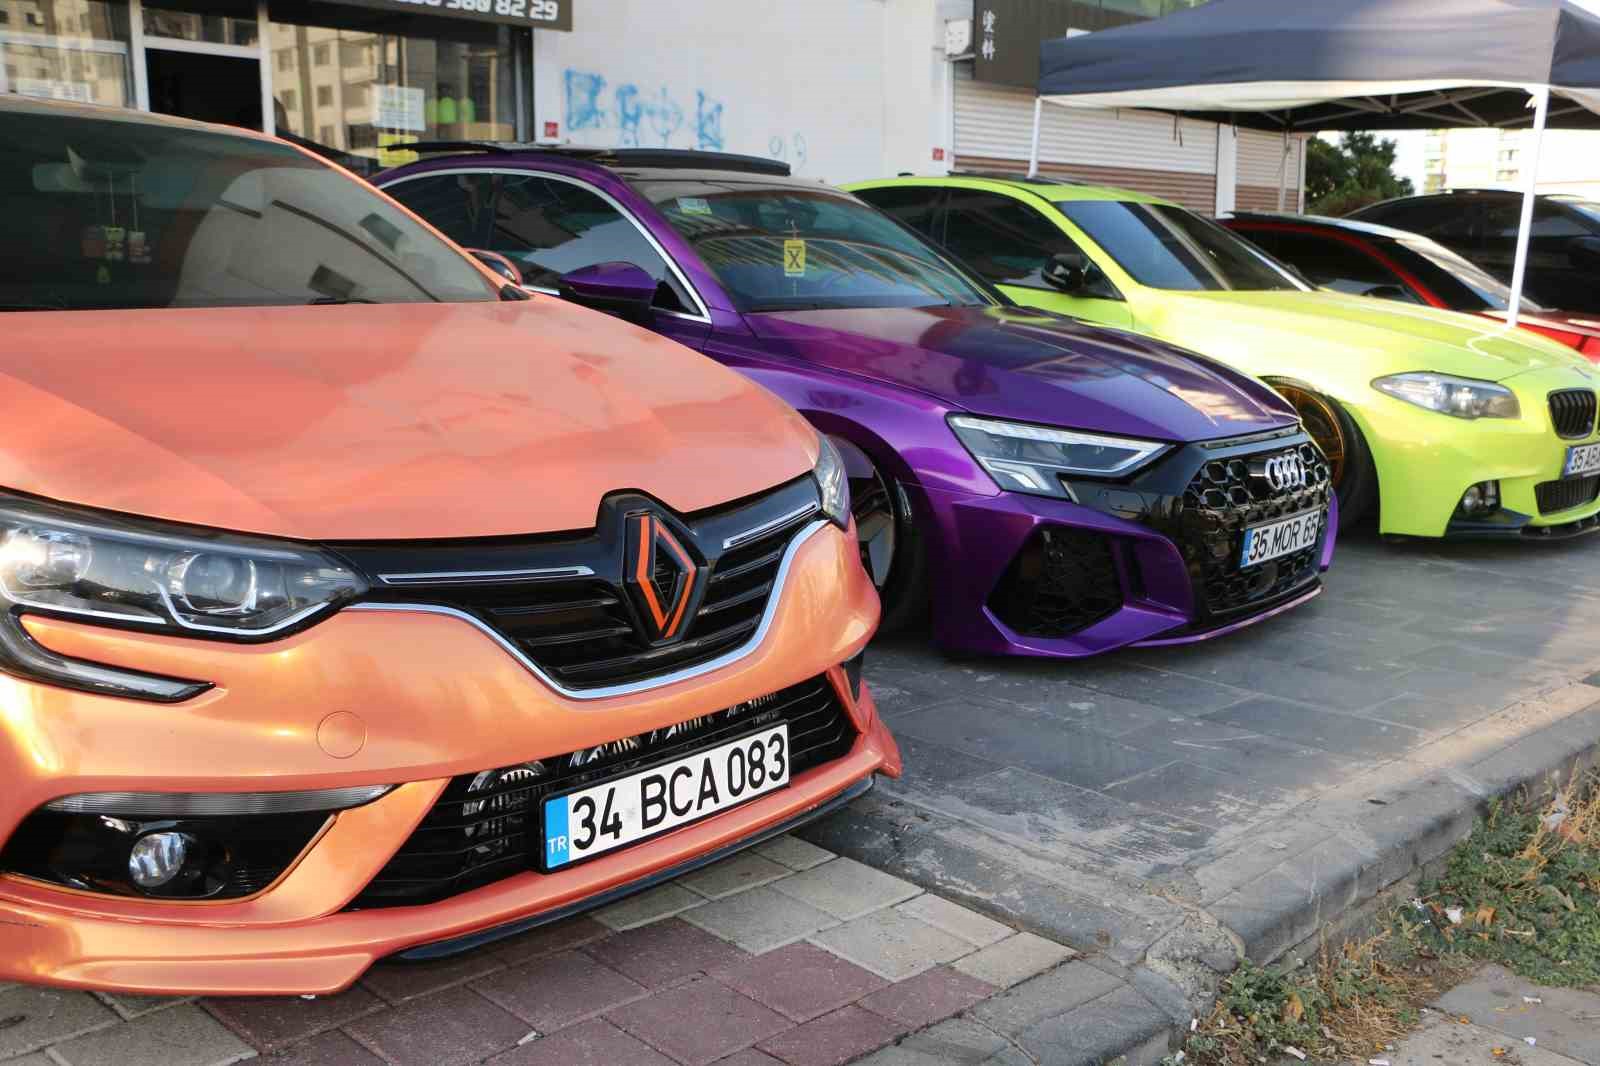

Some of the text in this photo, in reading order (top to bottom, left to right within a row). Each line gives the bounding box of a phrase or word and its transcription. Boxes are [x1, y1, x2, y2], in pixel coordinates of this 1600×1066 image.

[529, 0, 558, 21] 29
[1571, 448, 1585, 470] 35
[1271, 519, 1301, 555] MOR
[1303, 513, 1319, 543] 65
[572, 732, 786, 850] 34 BCA 083
[547, 837, 567, 854] TR
